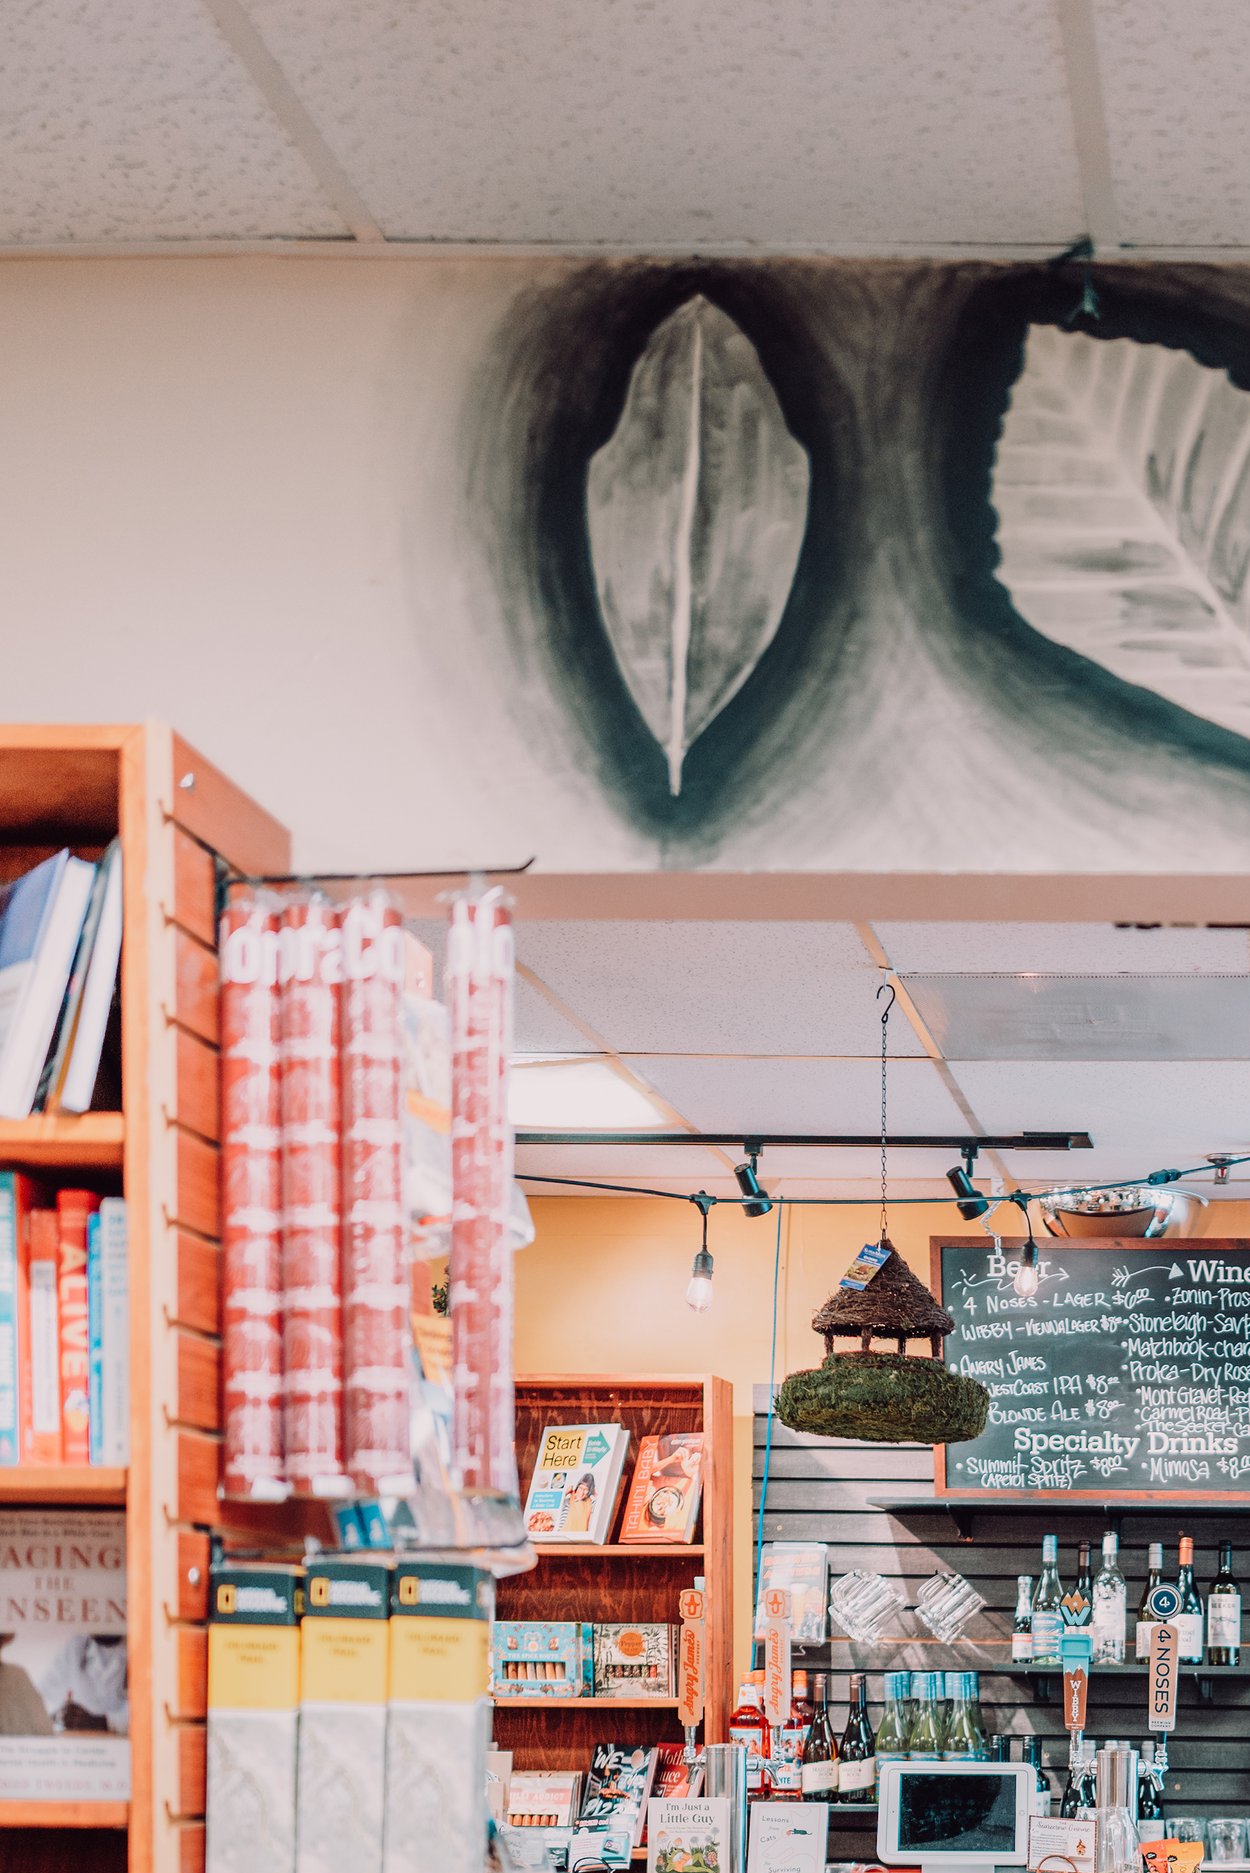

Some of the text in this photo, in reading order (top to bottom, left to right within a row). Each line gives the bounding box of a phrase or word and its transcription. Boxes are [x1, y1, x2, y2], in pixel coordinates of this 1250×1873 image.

[987, 1255, 1051, 1277] Ber
[60, 1242, 88, 1377] ALIVE
[962, 1296, 978, 1316] 4
[1052, 1292, 1112, 1310] LAGER
[1006, 1351, 1047, 1376] JAMES
[1053, 1375, 1083, 1395] IPA
[988, 1400, 1080, 1424] BLONDE ALE
[546, 1435, 583, 1451] Start
[1014, 1427, 1239, 1459] Specialty Drinks
[543, 1452, 577, 1467] Here
[966, 1452, 1088, 1479] Summit Spritz
[1150, 1456, 1210, 1482] Mimosa
[625, 1440, 659, 1532] TAHINI BABY
[0, 1544, 121, 1569] ACING
[7, 1597, 127, 1622] NSEEN
[1159, 1596, 1170, 1608] 4
[683, 1629, 698, 1716] Angry James
[769, 1629, 785, 1716] Angry James
[1154, 1629, 1171, 1713] 4 NOSES
[1070, 1680, 1082, 1722] WIBBY
[660, 1813, 716, 1826] Little Guy
[666, 1803, 680, 1811] I'm
[682, 1803, 702, 1811] Just
[760, 1835, 776, 1844] Cats
